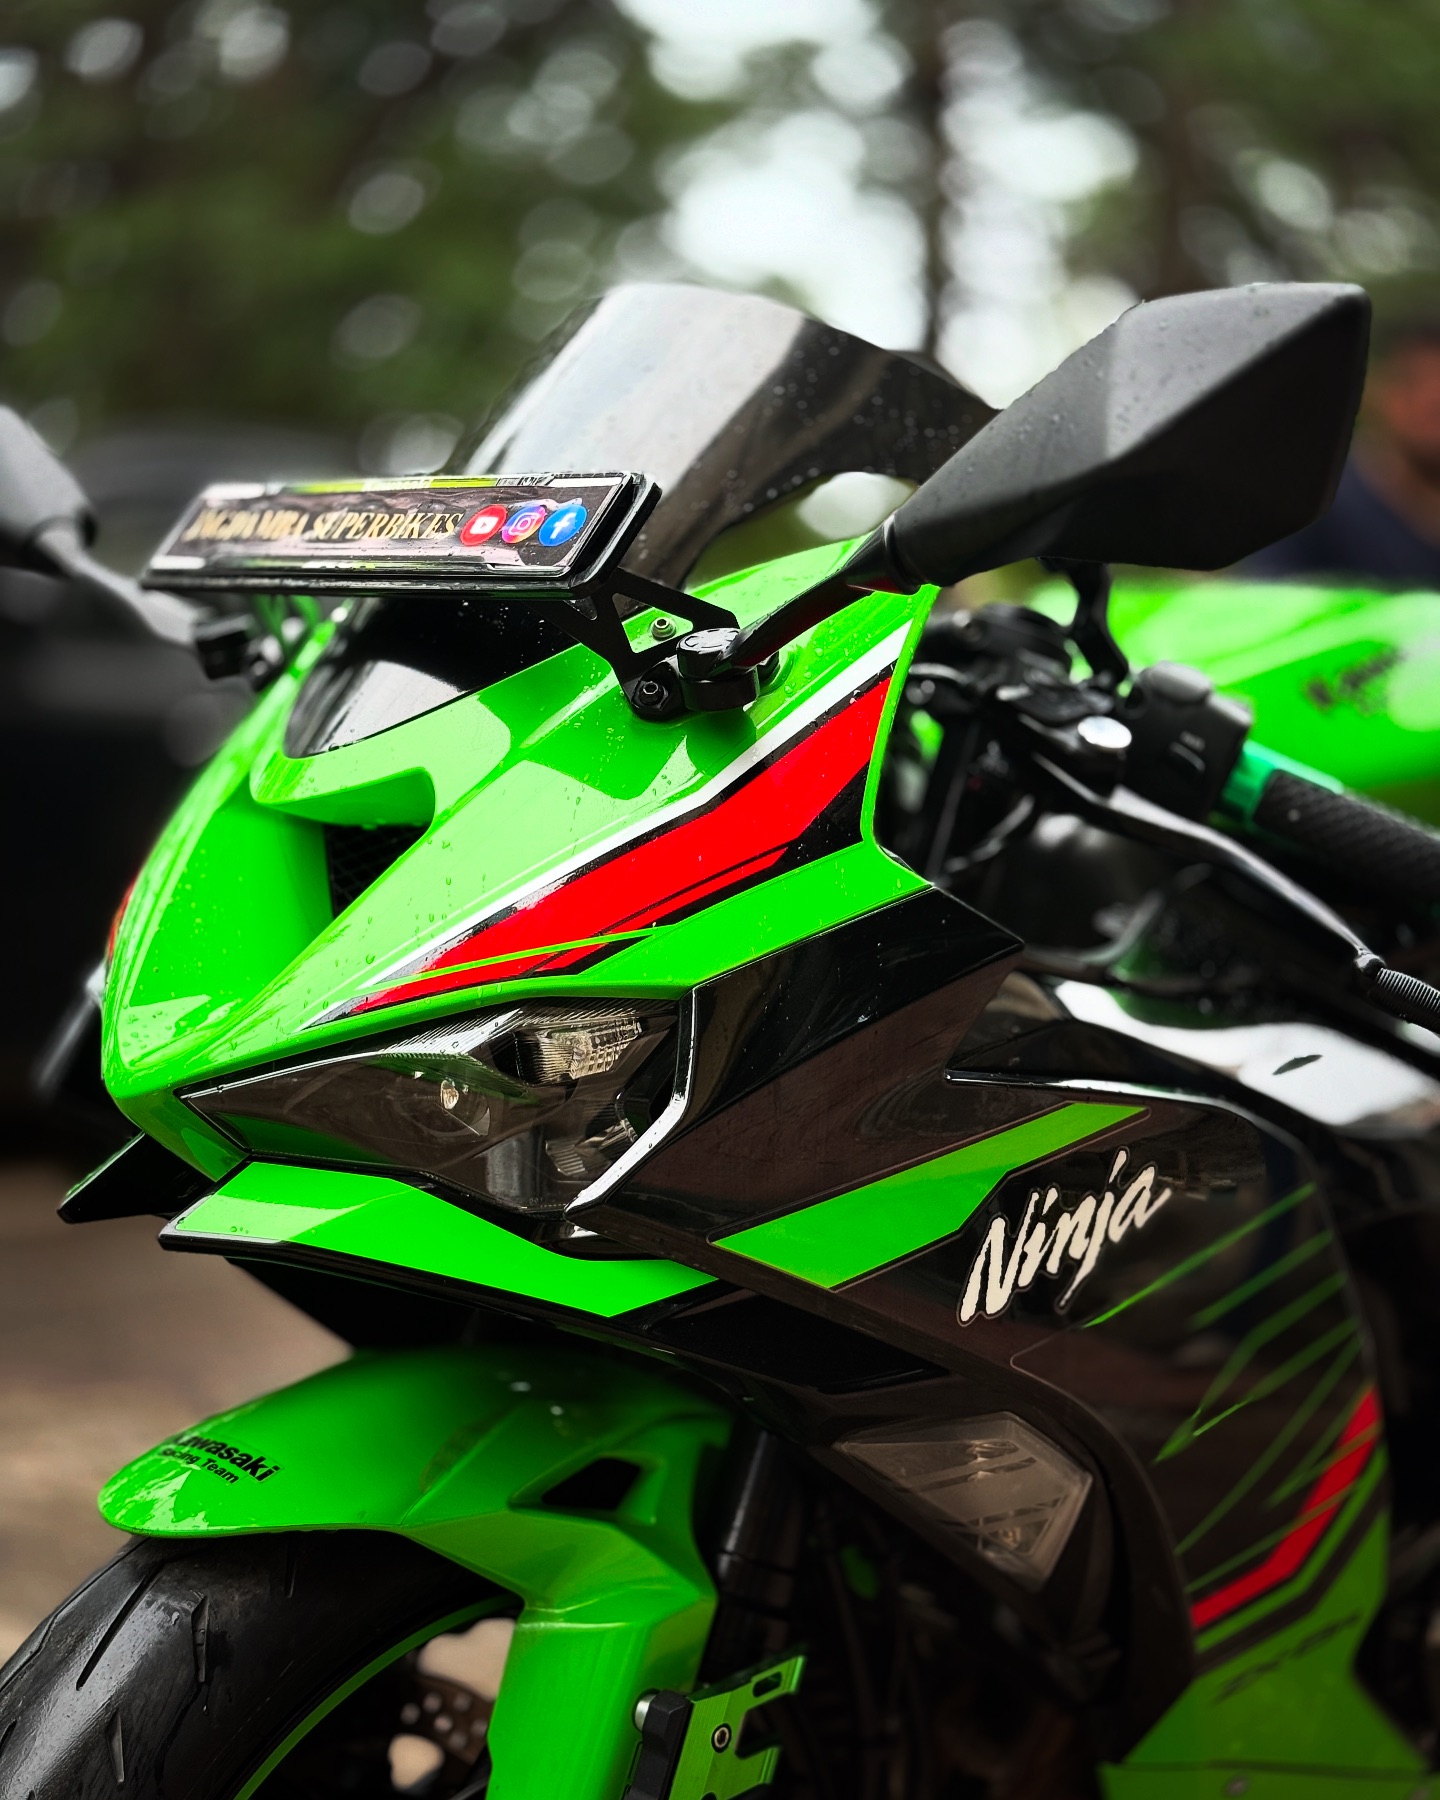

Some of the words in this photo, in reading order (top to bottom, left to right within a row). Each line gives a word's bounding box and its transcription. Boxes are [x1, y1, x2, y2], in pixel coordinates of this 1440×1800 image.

[303, 508, 464, 541] SUPERBIKES
[959, 1149, 1173, 1323] Ninja
[160, 1448, 201, 1465] acing
[201, 1457, 240, 1483] Team
